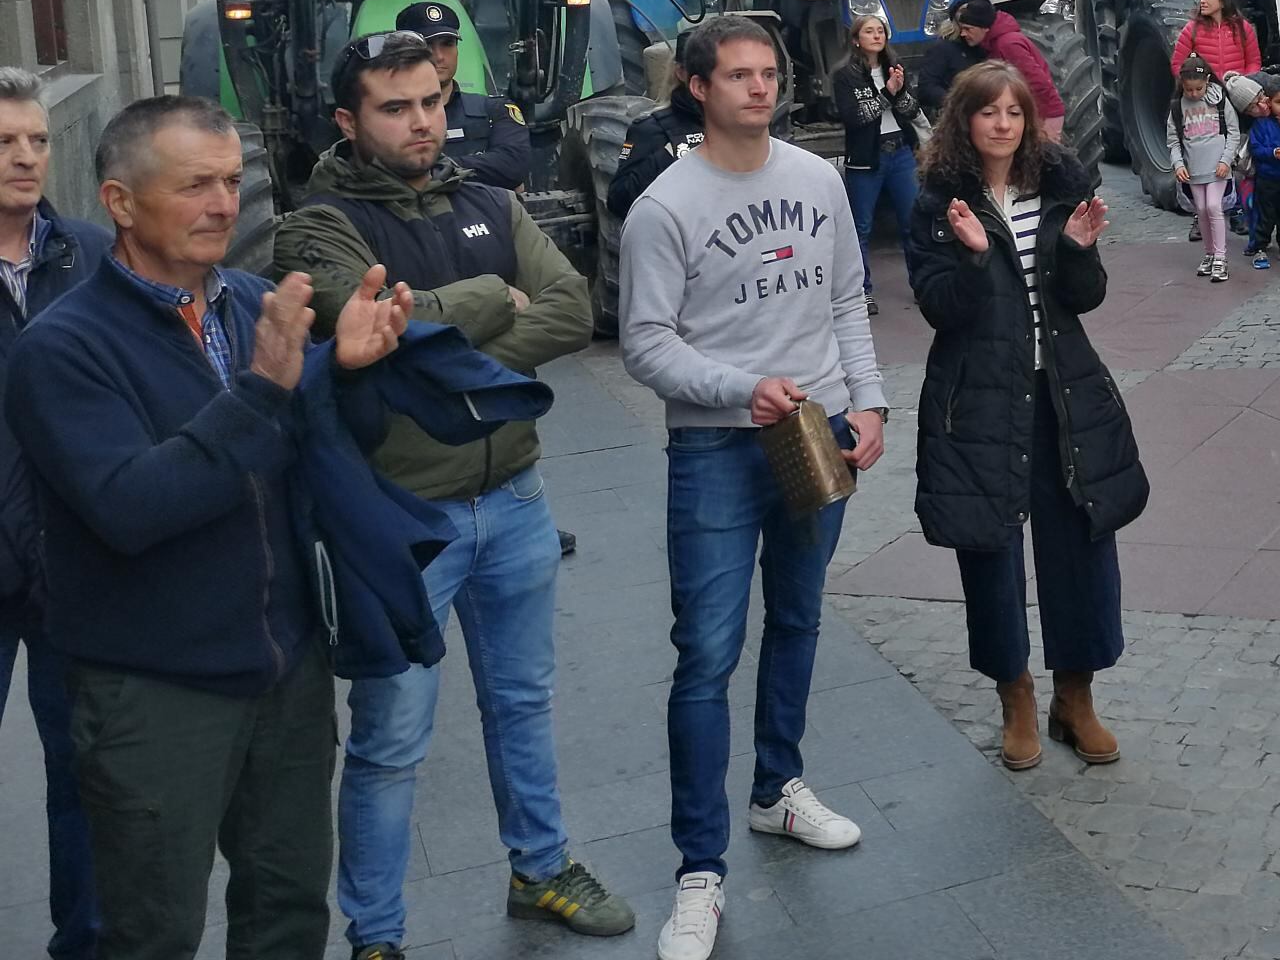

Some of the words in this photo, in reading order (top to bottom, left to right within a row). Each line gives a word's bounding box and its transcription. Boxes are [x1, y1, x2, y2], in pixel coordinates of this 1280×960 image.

[462, 223, 490, 238] HH
[705, 199, 828, 258] TOMMY
[734, 265, 823, 304] JEANS
